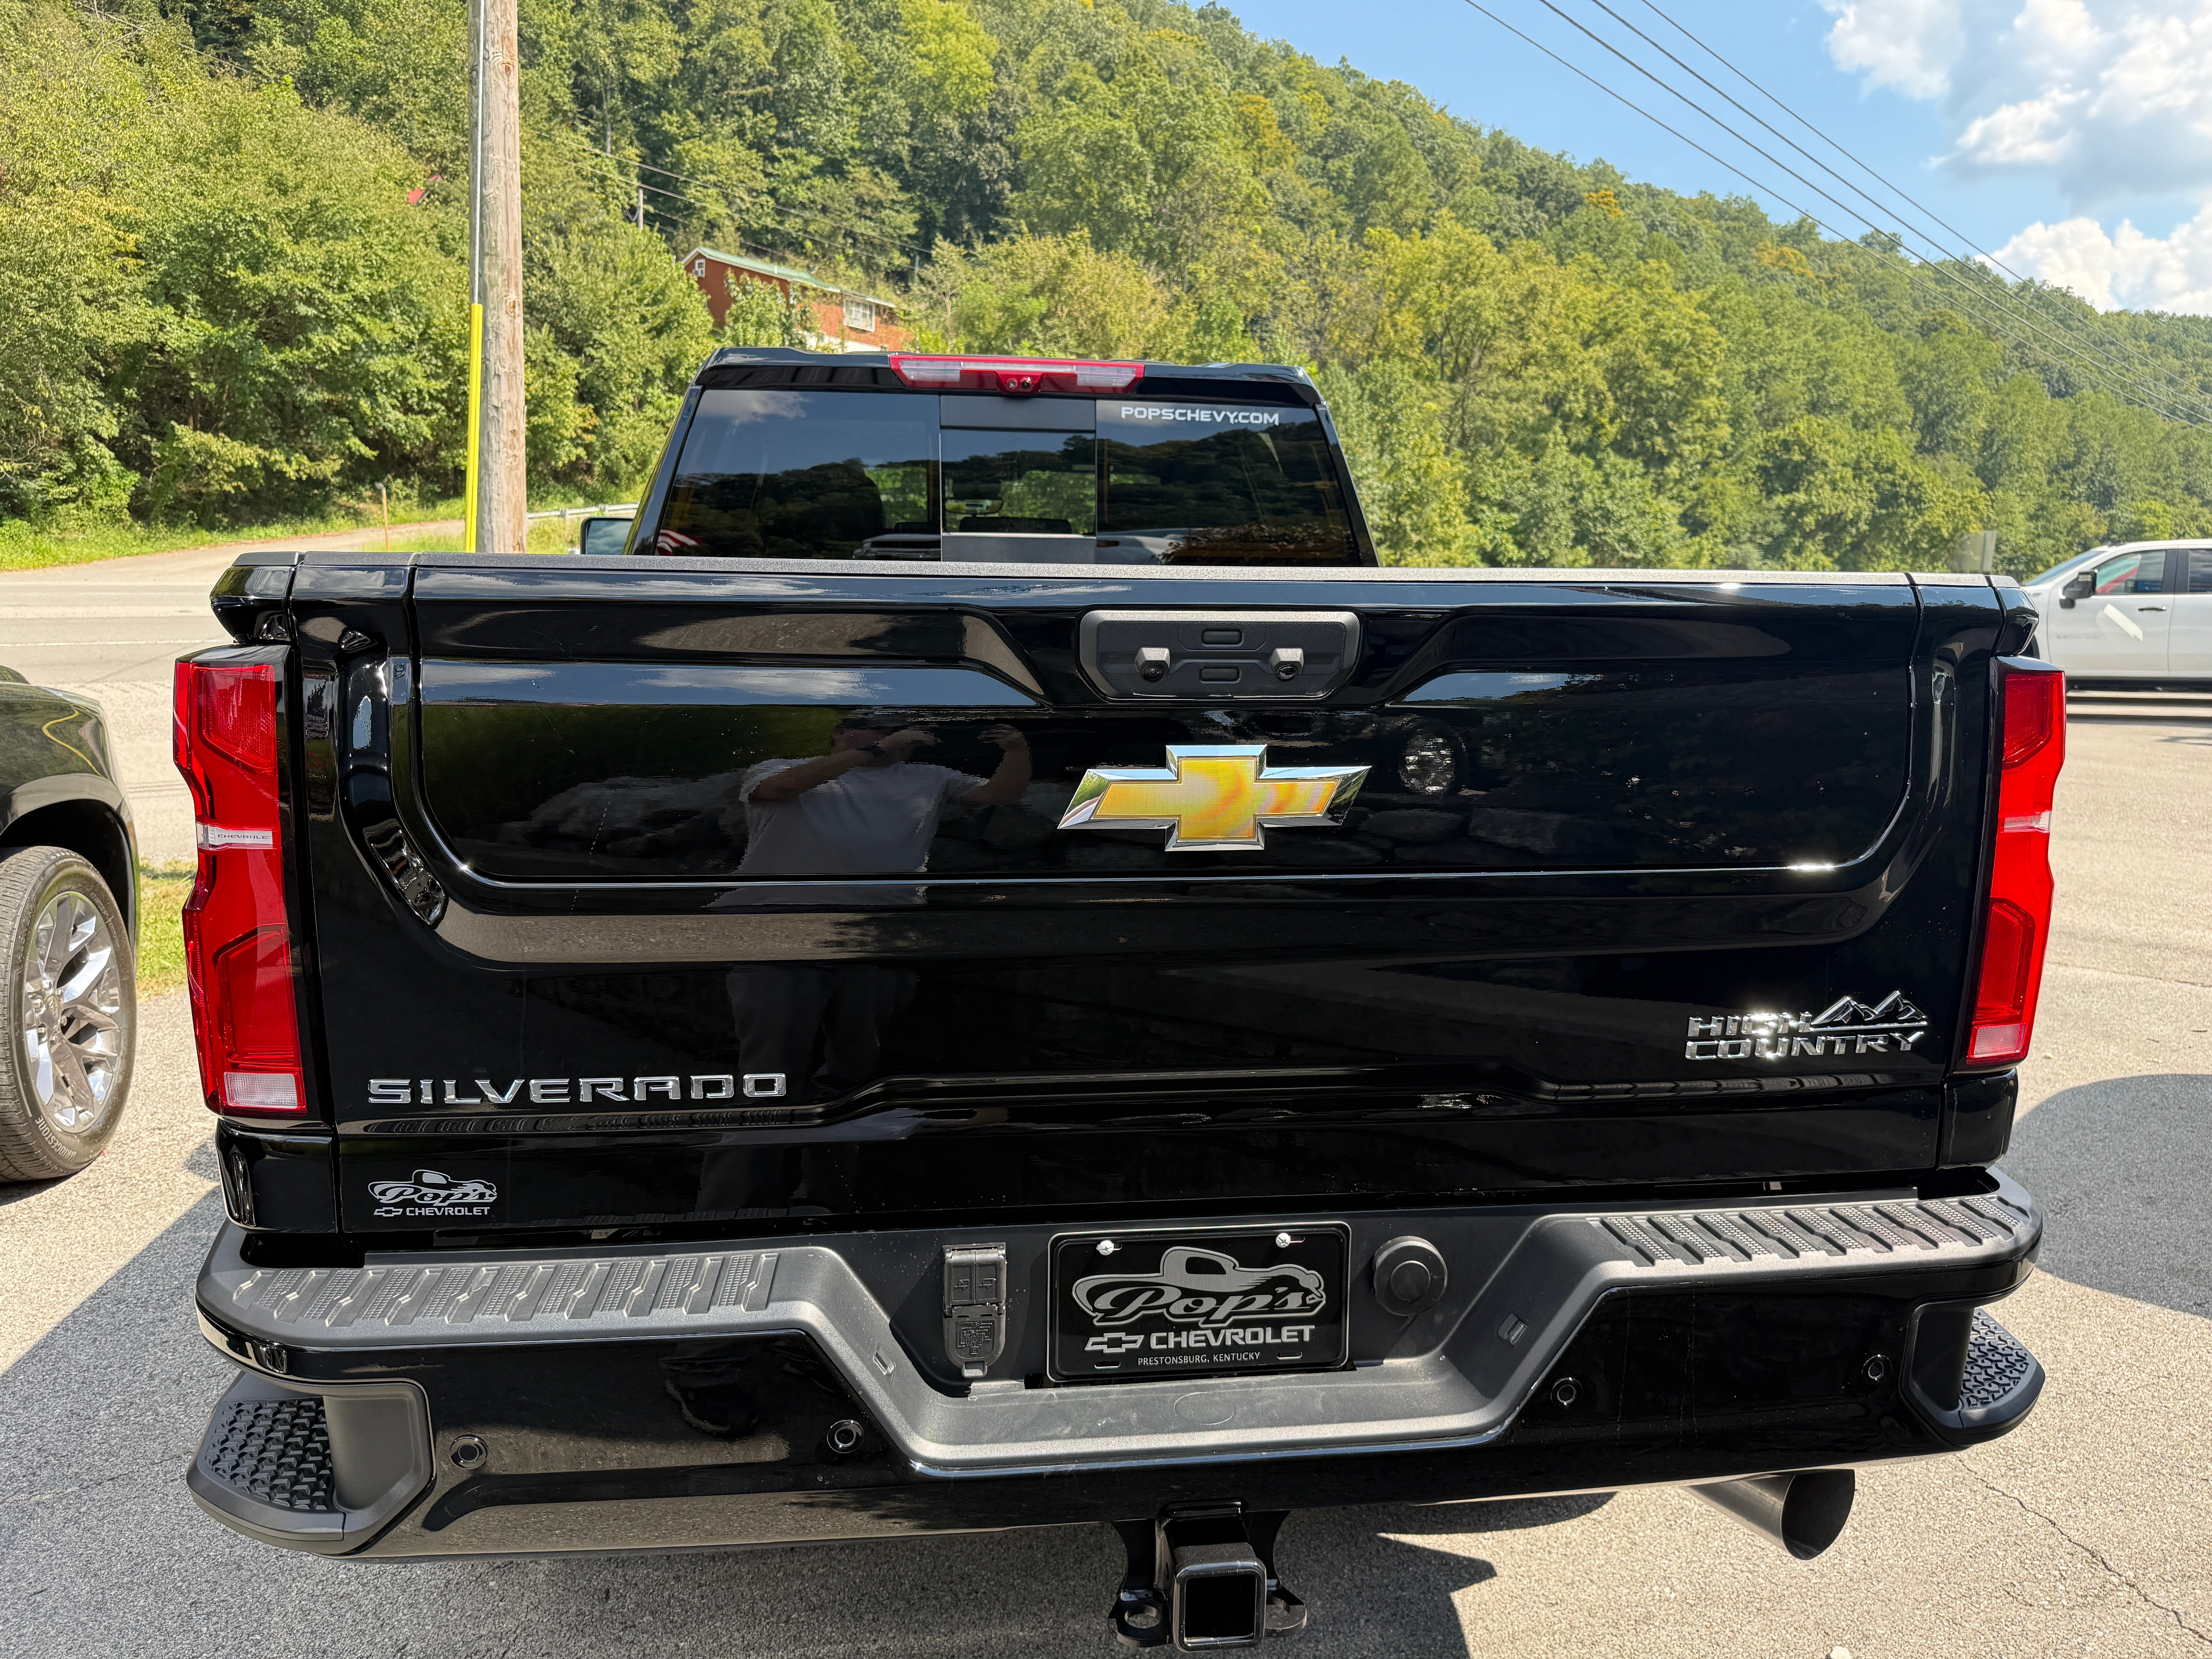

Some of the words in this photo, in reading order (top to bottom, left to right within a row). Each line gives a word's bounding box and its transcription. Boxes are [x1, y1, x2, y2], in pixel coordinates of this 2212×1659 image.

[1121, 407, 1279, 426] POPSCHEVY.COM
[1688, 1011, 1812, 1037] HIGH
[1685, 1031, 1924, 1060] COUNTRY
[368, 1073, 787, 1104] SILVERADO
[35, 1115, 77, 1162] BRIDGESTONE
[406, 1207, 490, 1216] CHEVROLET
[1094, 1286, 1310, 1319] Pop's
[1149, 1325, 1315, 1349] CHEVROLET
[1138, 1354, 1210, 1365] PRESTONSBURG,
[1213, 1351, 1261, 1362] KENTUCKY
